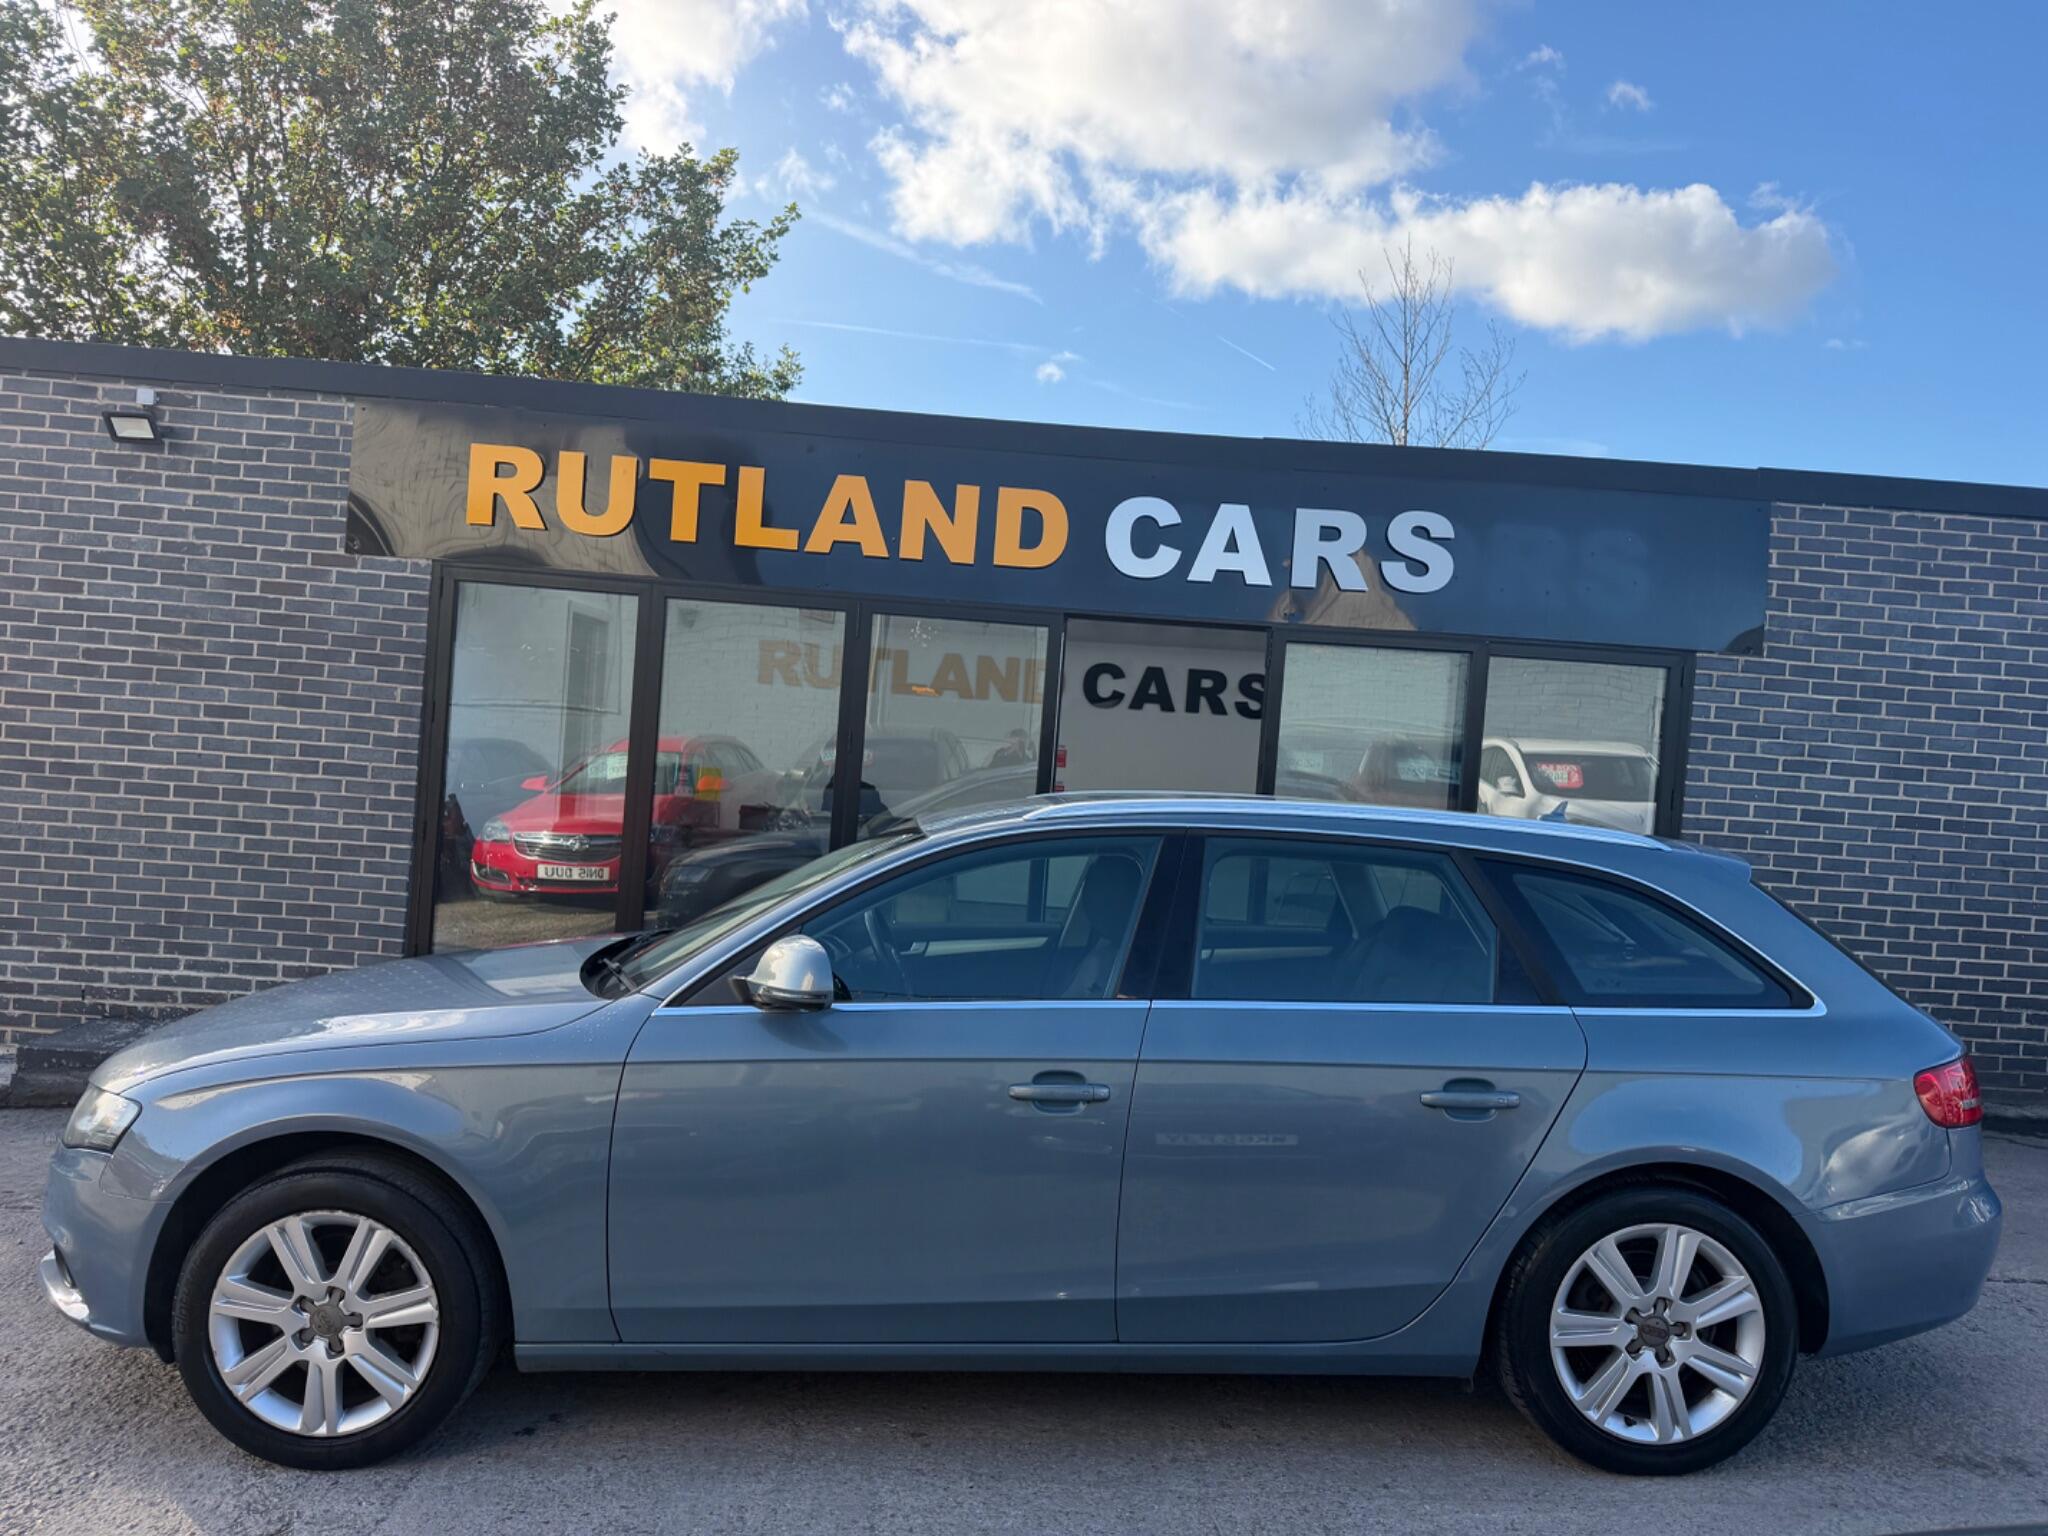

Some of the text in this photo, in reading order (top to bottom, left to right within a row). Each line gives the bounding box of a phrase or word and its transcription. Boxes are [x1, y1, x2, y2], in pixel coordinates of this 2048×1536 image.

[466, 443, 1455, 594] RUTLAND CARS
[1082, 662, 1266, 720] CARS
